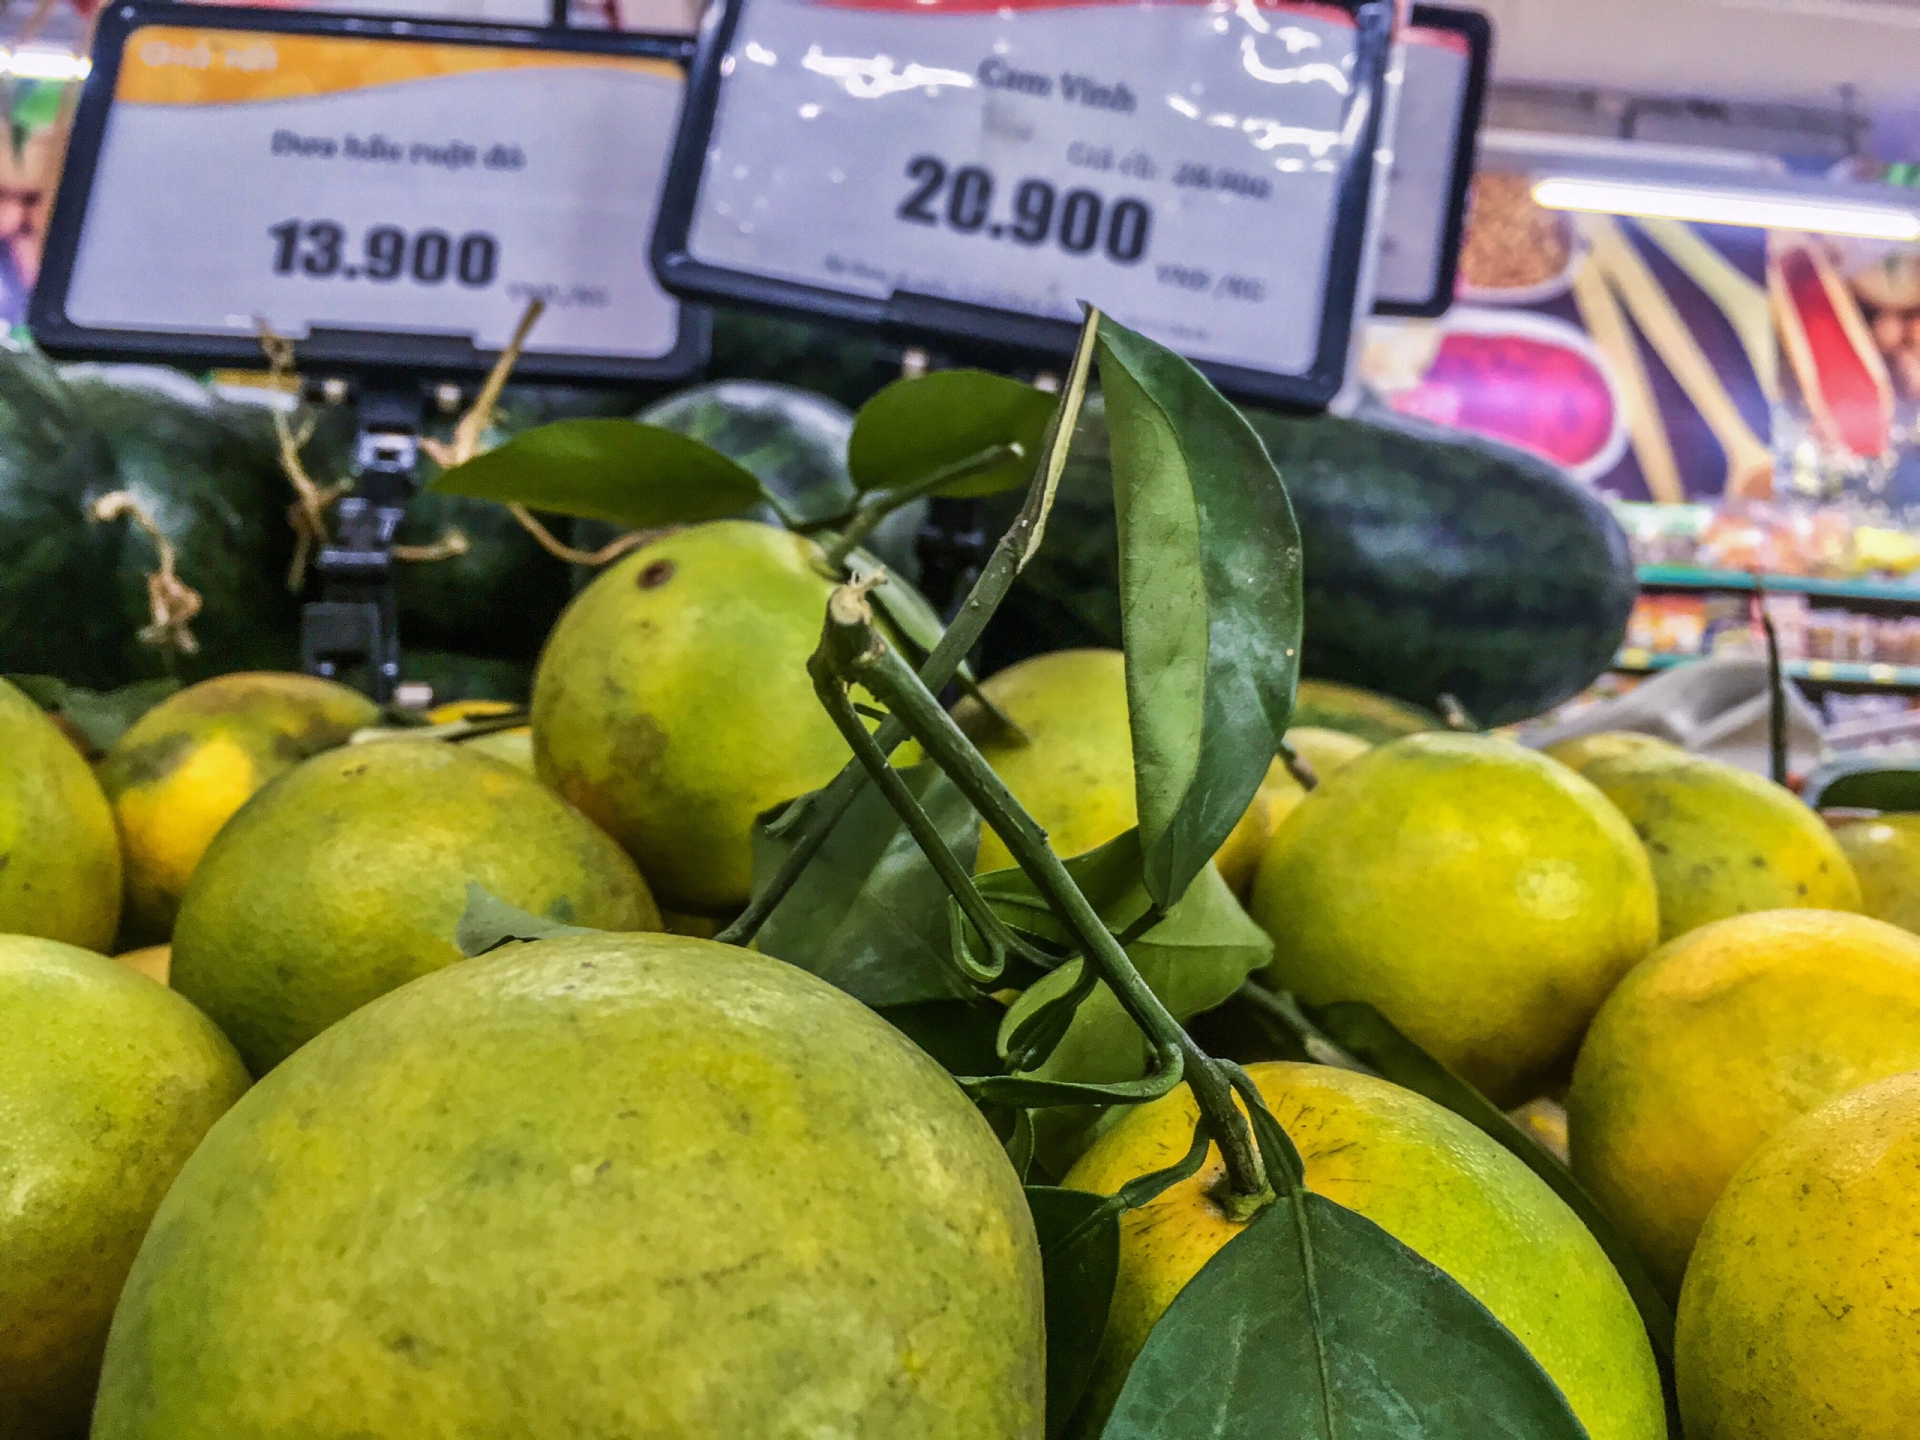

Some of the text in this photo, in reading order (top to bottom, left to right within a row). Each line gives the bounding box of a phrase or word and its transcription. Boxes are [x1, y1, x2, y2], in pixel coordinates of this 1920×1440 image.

[976, 55, 1137, 115] Cam Vinh
[898, 155, 1153, 266] 20.900
[268, 217, 500, 289] 13.900
